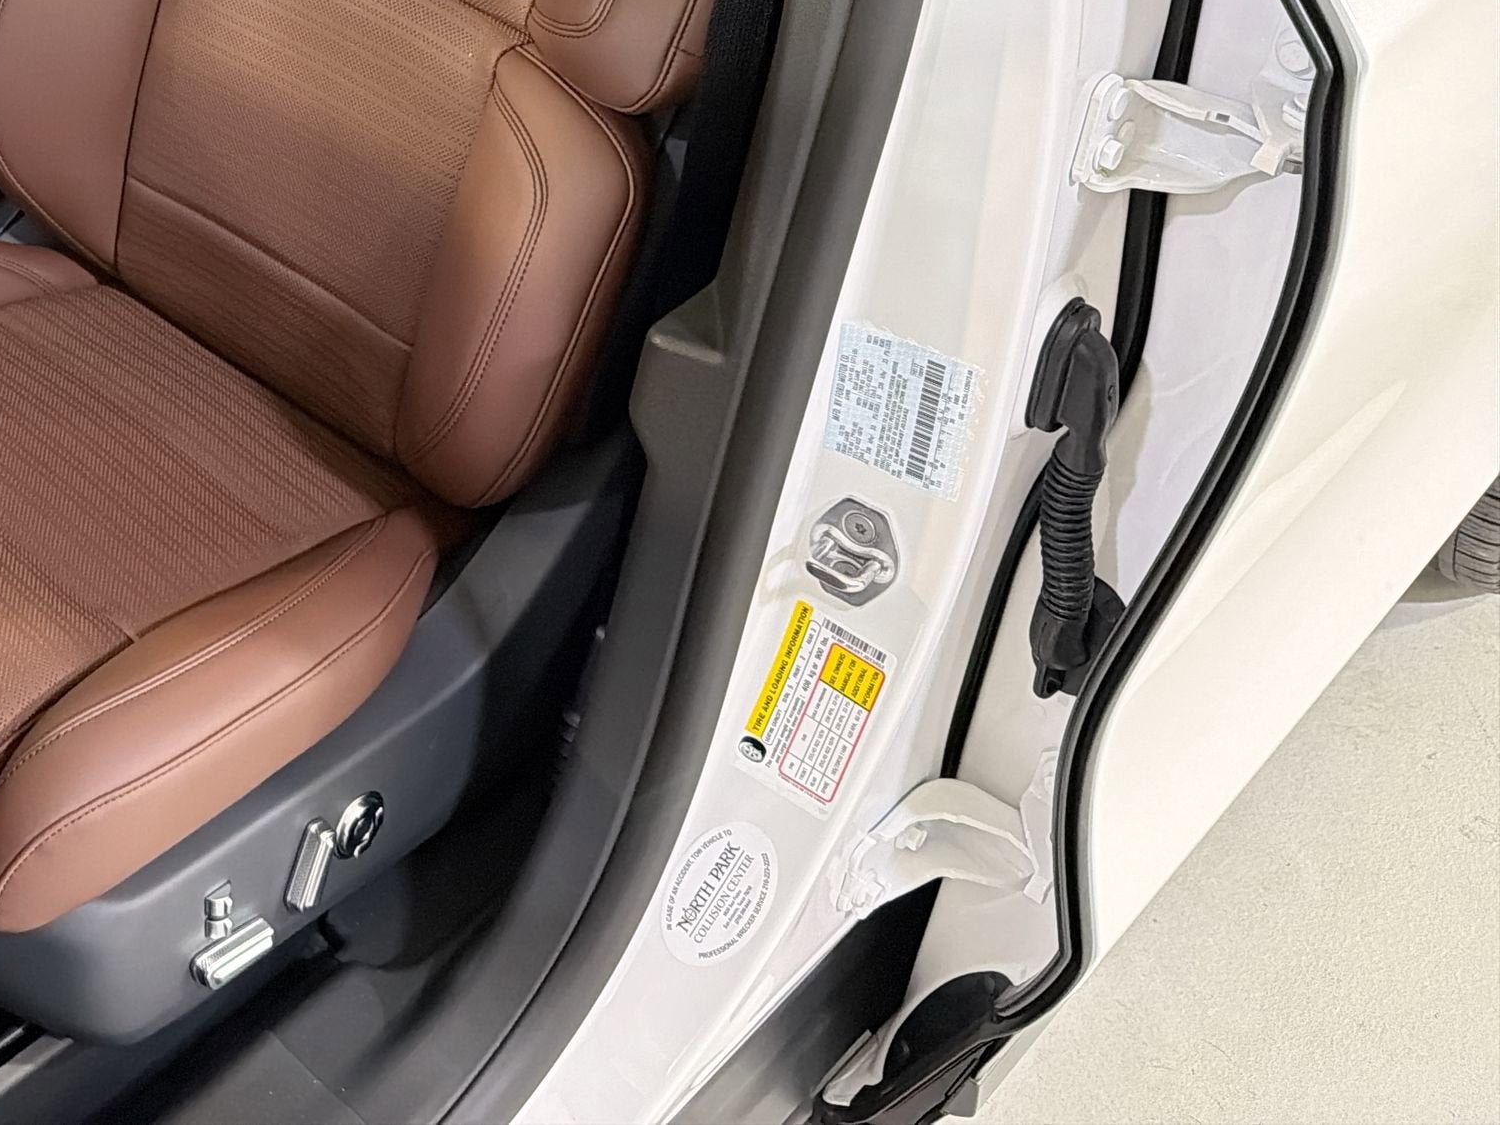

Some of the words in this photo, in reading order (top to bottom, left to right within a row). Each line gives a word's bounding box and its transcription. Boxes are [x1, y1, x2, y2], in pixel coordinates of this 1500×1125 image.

[752, 711, 765, 732] TIRE
[761, 694, 773, 712] AND
[770, 659, 789, 696] LOADING
[785, 605, 810, 658] INFORMATION
[806, 668, 817, 679] kg
[828, 674, 837, 685] SEE
[838, 669, 852, 692] MANUAL
[847, 658, 857, 670] FOR
[849, 666, 867, 698] ADDITIONAL
[860, 670, 880, 706] INFORMATION
[690, 847, 703, 861] TOW
[700, 831, 724, 850] VEHICLE
[668, 894, 676, 905] OF
[675, 879, 716, 933] NORTH
[707, 840, 742, 885] PARK
[693, 890, 731, 944] COLLISION
[726, 854, 755, 893] CENTER
[665, 904, 675, 923] CASE
[698, 937, 740, 959] PROFESSIONAL
[735, 913, 758, 939] WRECKER
[752, 890, 768, 915] SERVICE
